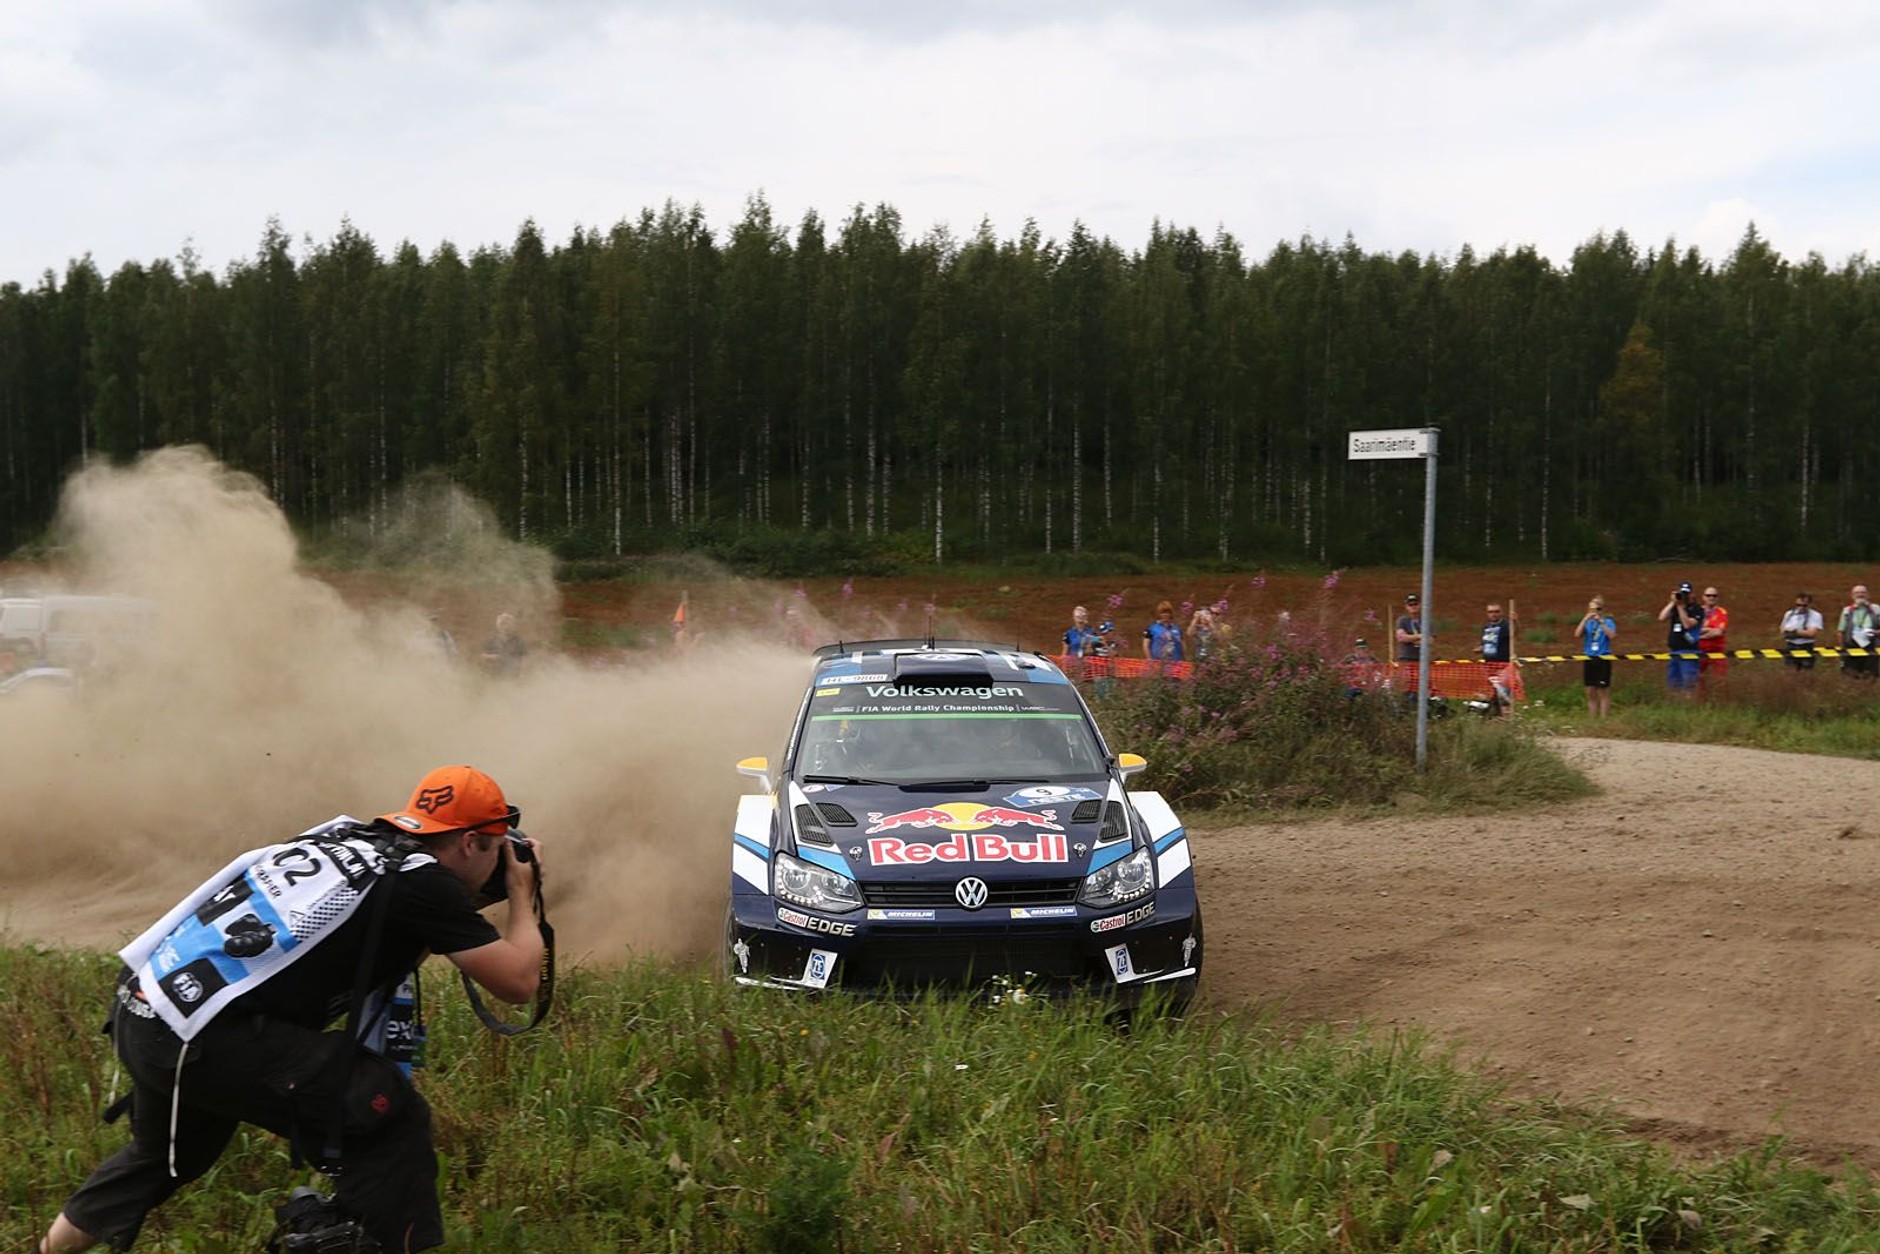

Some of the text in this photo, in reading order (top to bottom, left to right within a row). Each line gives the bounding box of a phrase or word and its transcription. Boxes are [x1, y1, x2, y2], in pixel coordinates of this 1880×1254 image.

[866, 685, 1024, 700] Volkswagen
[943, 704, 1015, 712] Championship
[1035, 788, 1053, 796] 9
[869, 834, 1067, 865] Red Bull
[887, 911, 934, 919] MICHELIN
[1030, 908, 1075, 916] MICHELIN
[1099, 902, 1157, 931] Castrol EDGE
[783, 910, 858, 937] Castrol EDGE
